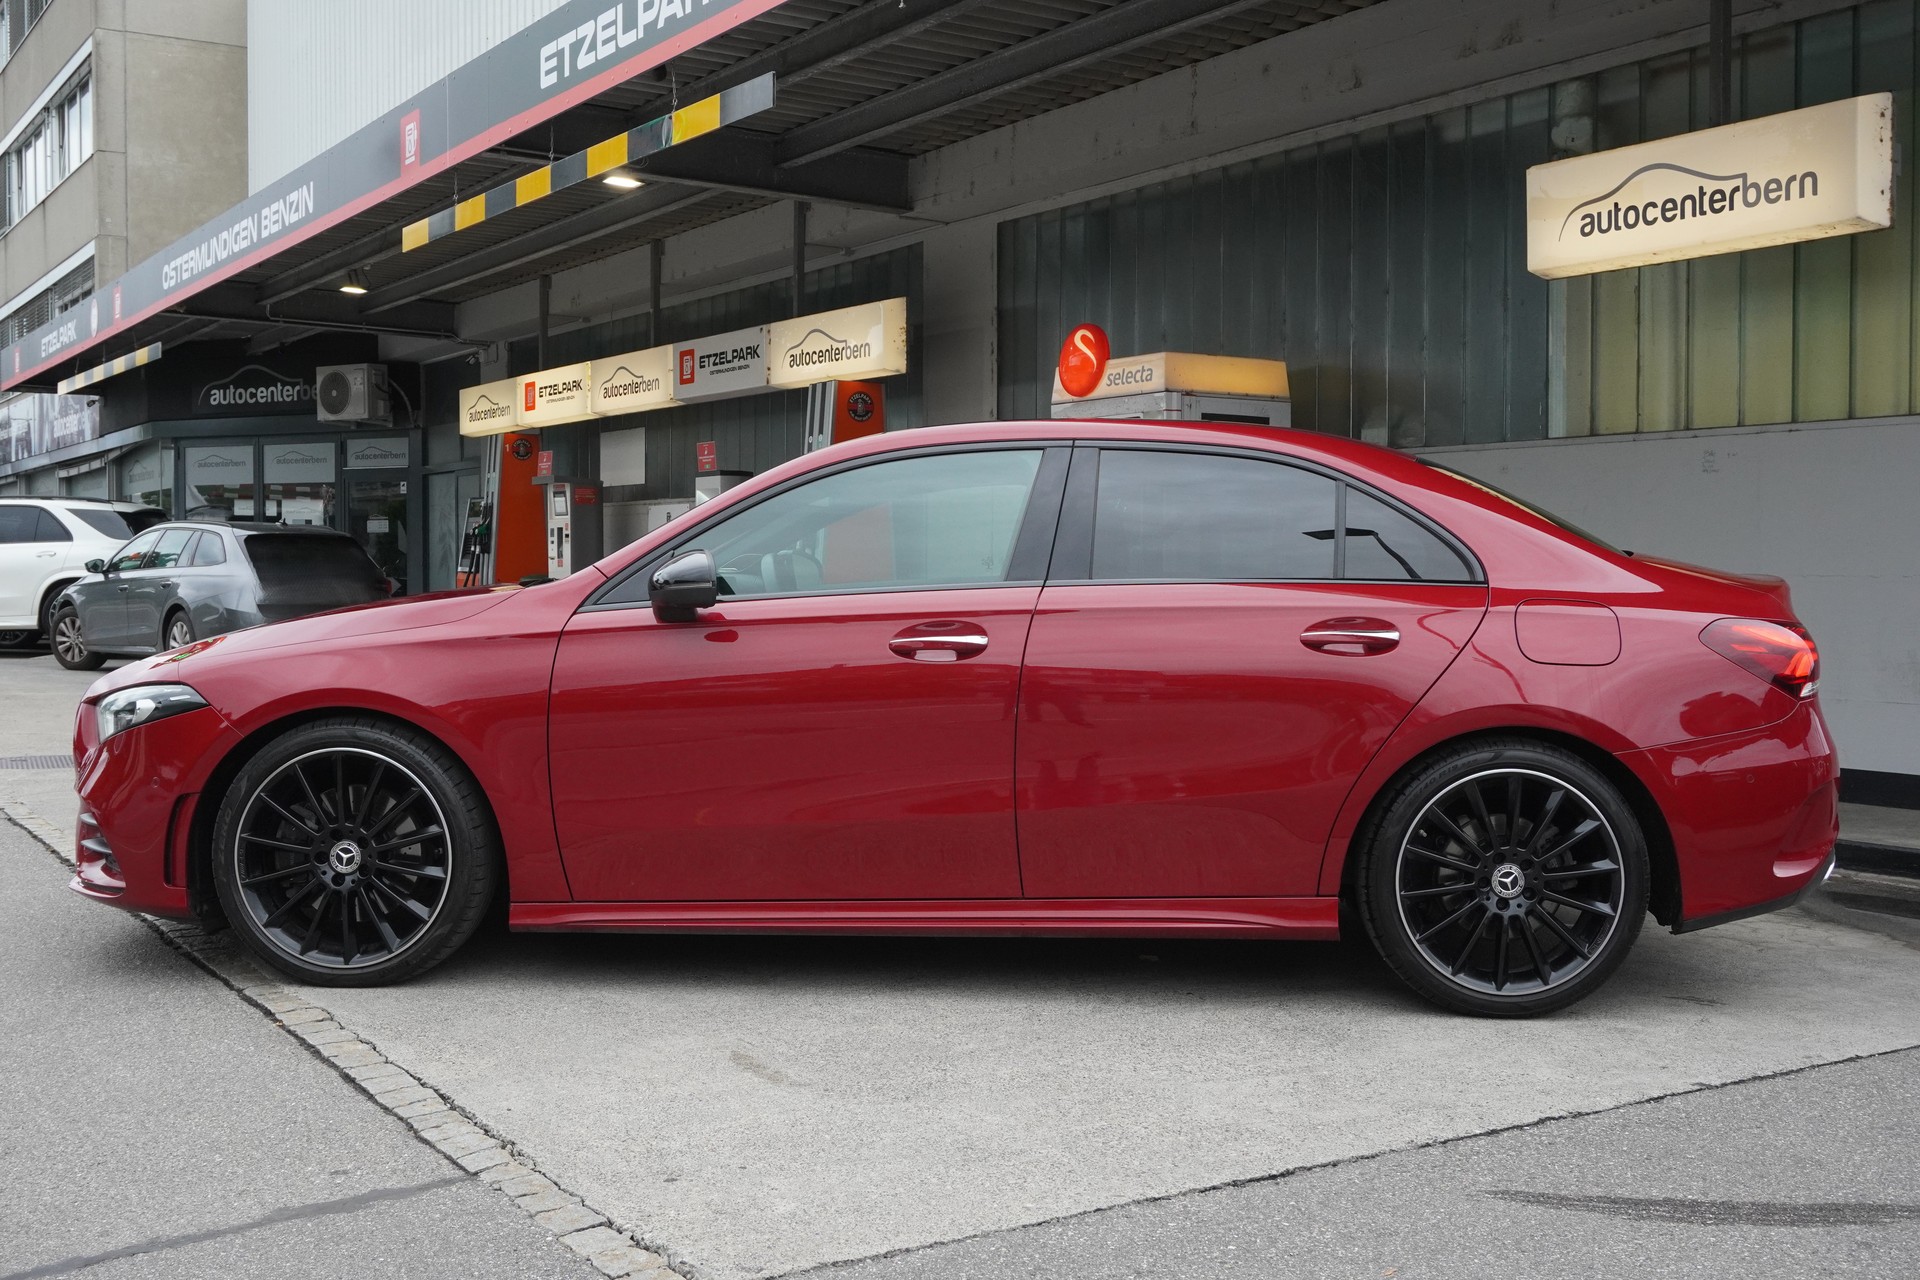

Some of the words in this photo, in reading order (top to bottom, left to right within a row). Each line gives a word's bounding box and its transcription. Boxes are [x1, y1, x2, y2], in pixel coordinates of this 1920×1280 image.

[540, 0, 712, 90] ETZELPA
[1579, 171, 1819, 238] autocenterbern
[162, 213, 258, 290] OSTERMUNDIGEN
[261, 181, 314, 239] BENZIN
[41, 319, 77, 358] ETZELPARK
[699, 344, 760, 369] ETZELPARK
[789, 339, 871, 368] autocenterbern
[603, 375, 660, 399] autocenterbern
[1106, 364, 1154, 387] selecta
[209, 379, 318, 405] autocenterbe
[538, 379, 583, 398] ETZELPARK
[469, 402, 511, 422] autocenterbern
[354, 450, 406, 461] autocenterbern
[505, 443, 510, 452] 1
[276, 455, 328, 465] autocenterbern
